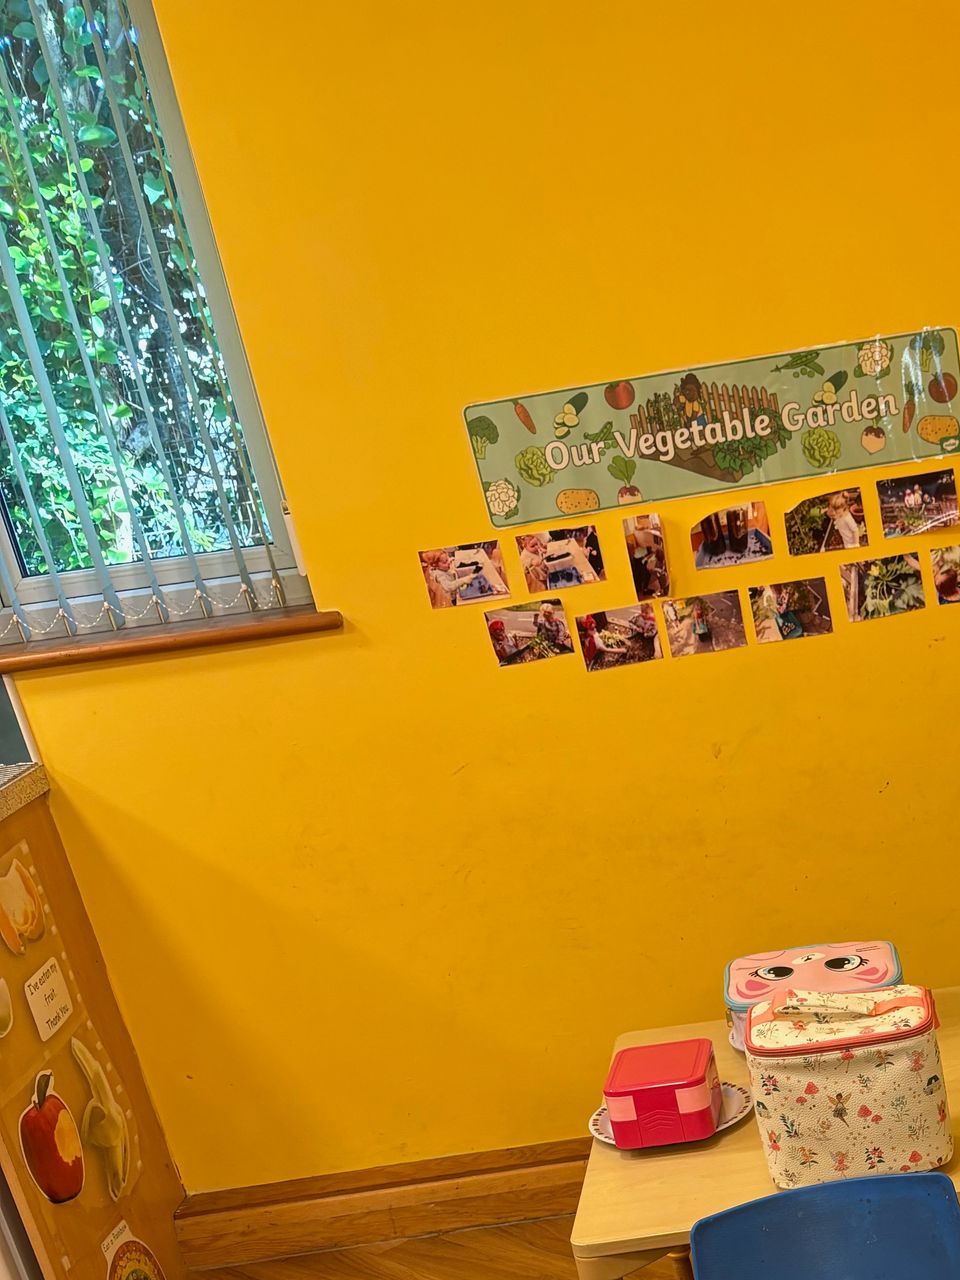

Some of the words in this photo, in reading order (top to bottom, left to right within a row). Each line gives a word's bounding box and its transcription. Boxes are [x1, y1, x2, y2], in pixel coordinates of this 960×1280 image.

[544, 440, 606, 470] Our
[613, 407, 773, 462] Vegetable
[781, 389, 899, 432] Garden
